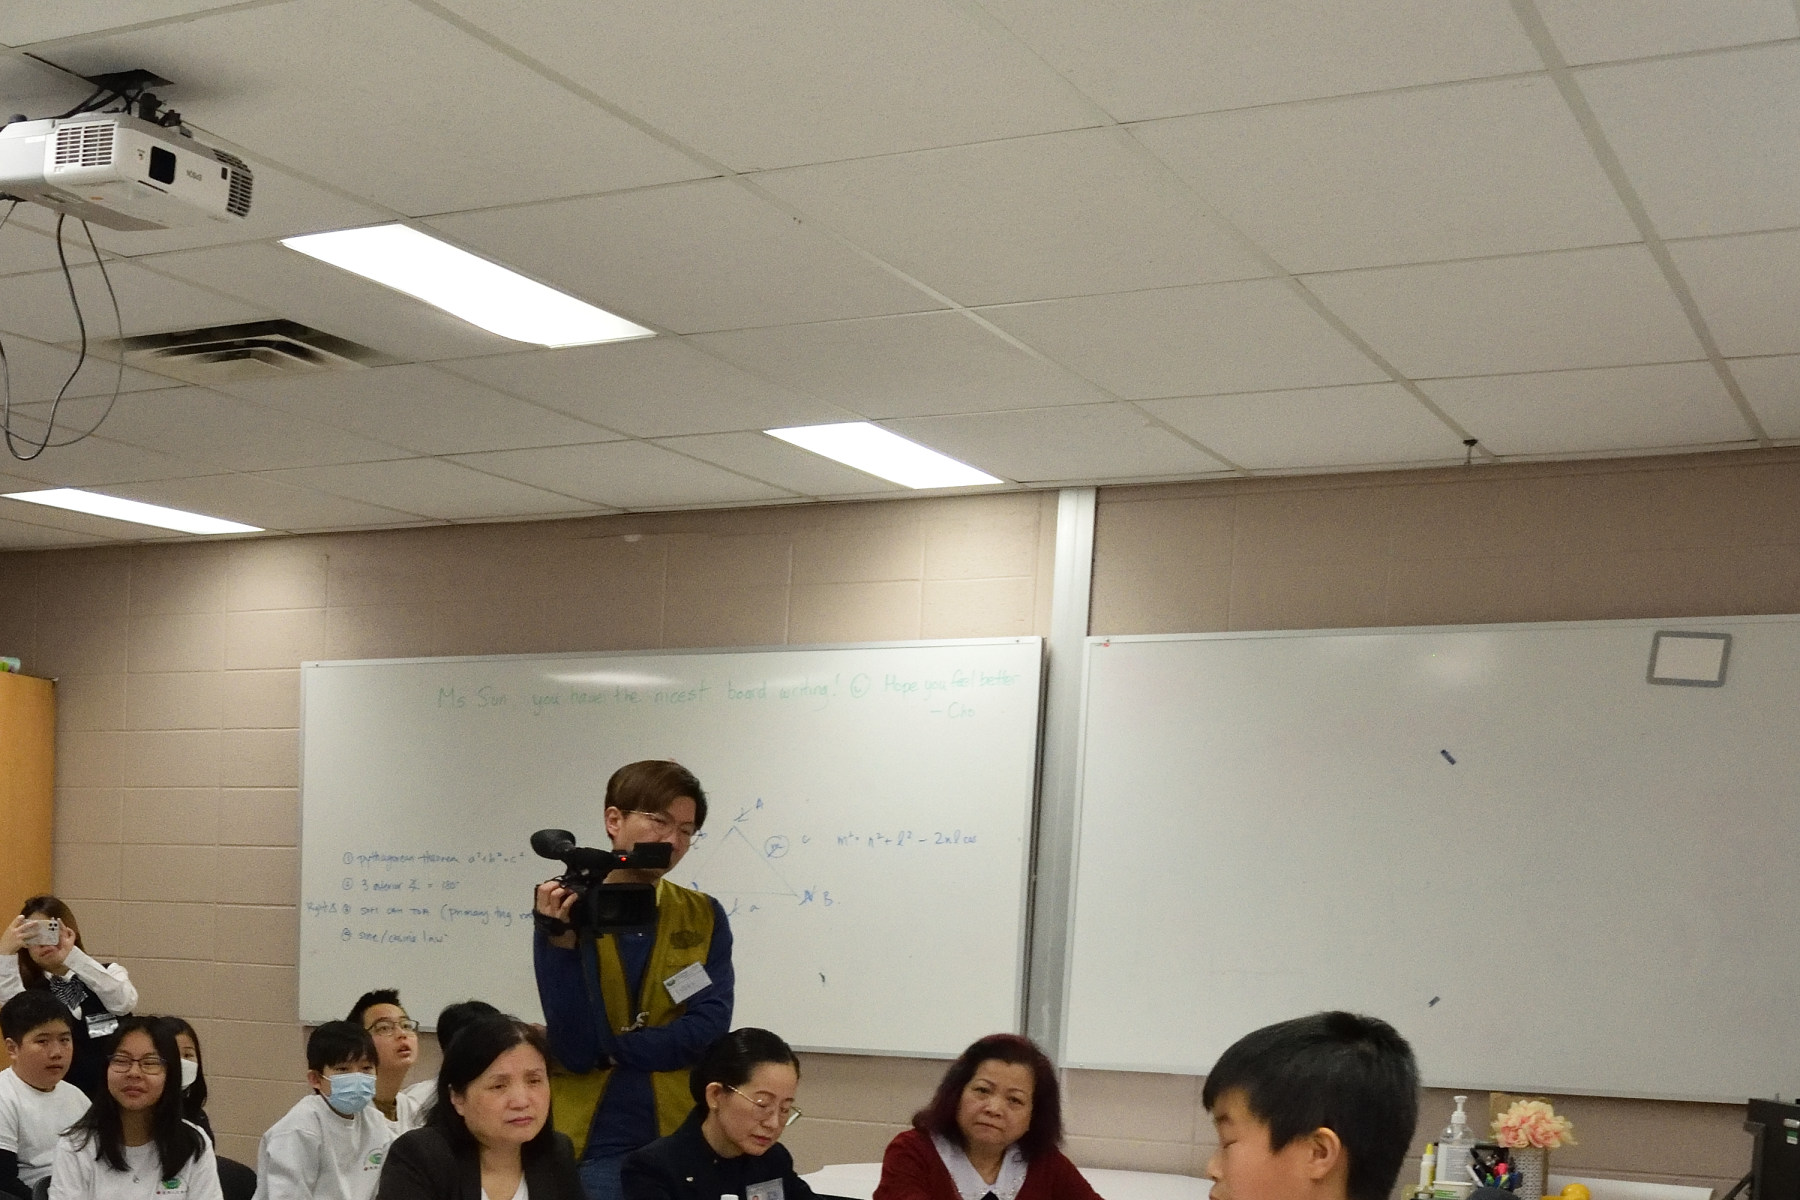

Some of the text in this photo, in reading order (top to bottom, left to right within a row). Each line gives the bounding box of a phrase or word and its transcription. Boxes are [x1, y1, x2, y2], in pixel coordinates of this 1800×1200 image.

[437, 687, 466, 708] Ms
[531, 693, 561, 715] you
[569, 684, 604, 704] have
[613, 684, 642, 704] the
[655, 680, 712, 704] nicest
[727, 679, 767, 701] board
[884, 673, 918, 694] Hope
[924, 681, 948, 701] you
[951, 669, 975, 688] feel
[980, 670, 1020, 687] better
